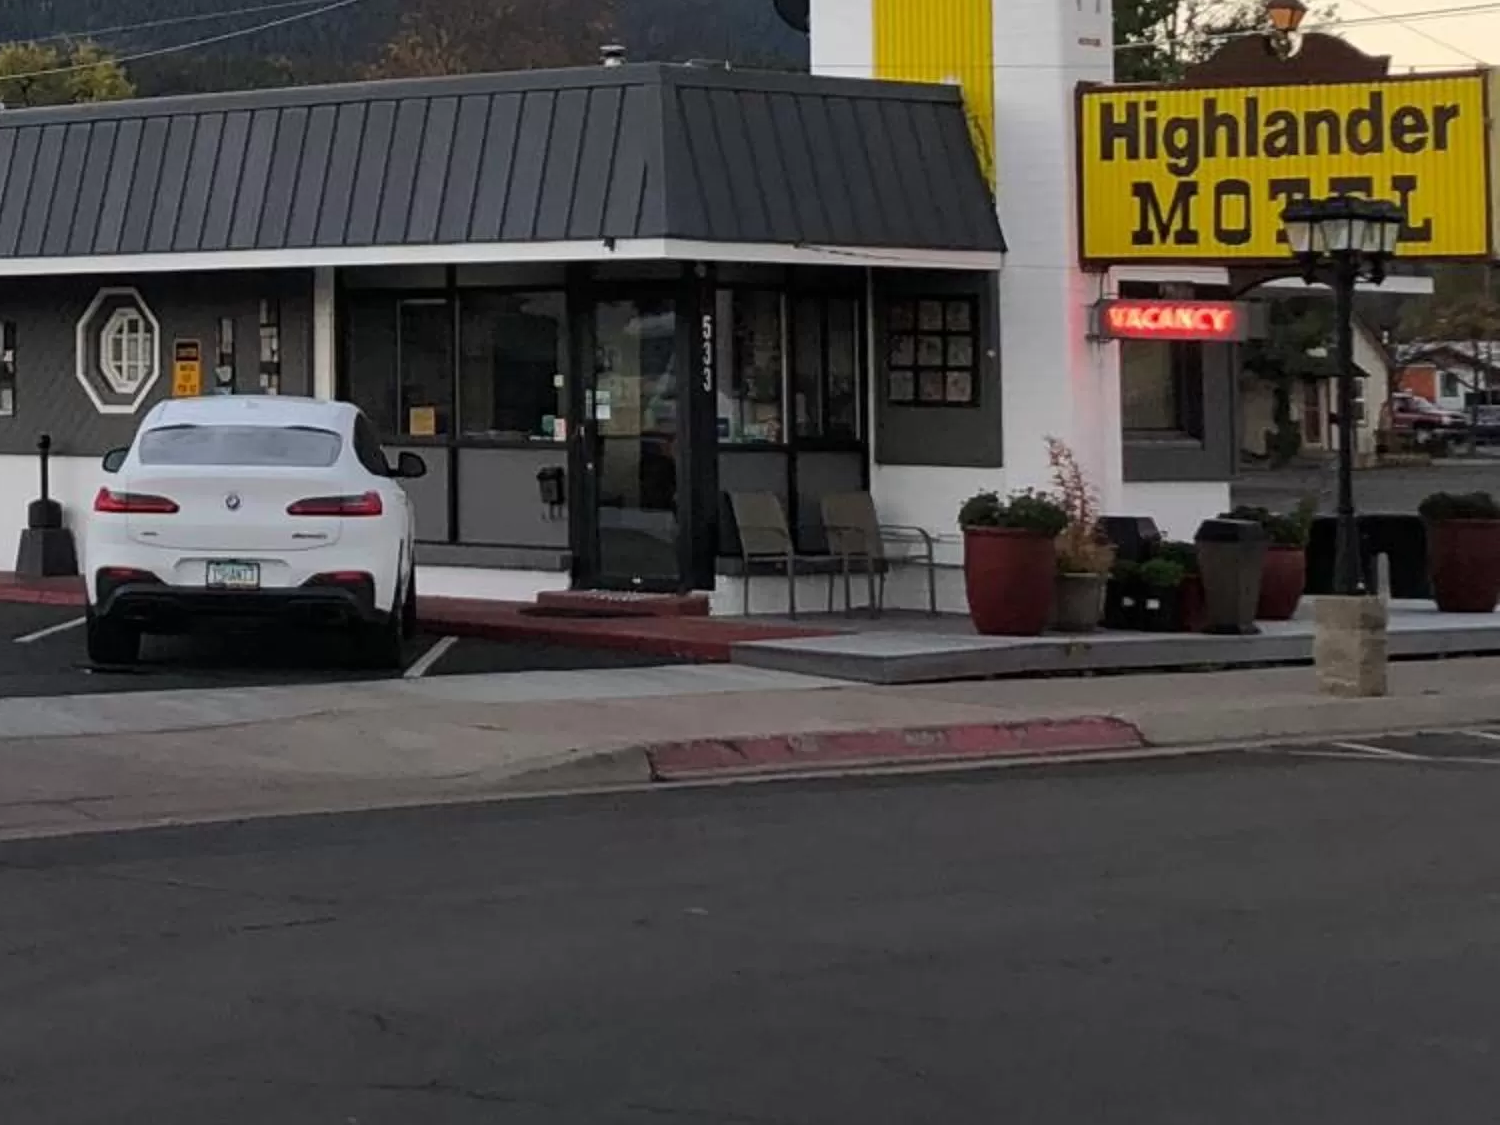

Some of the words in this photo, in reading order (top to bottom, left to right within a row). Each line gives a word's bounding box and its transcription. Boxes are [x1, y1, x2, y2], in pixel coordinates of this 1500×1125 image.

[1100, 90, 1460, 176] Highlander
[1131, 175, 1432, 247] MOL
[702, 315, 712, 392] 533
[1108, 306, 1233, 332] VACANCY
